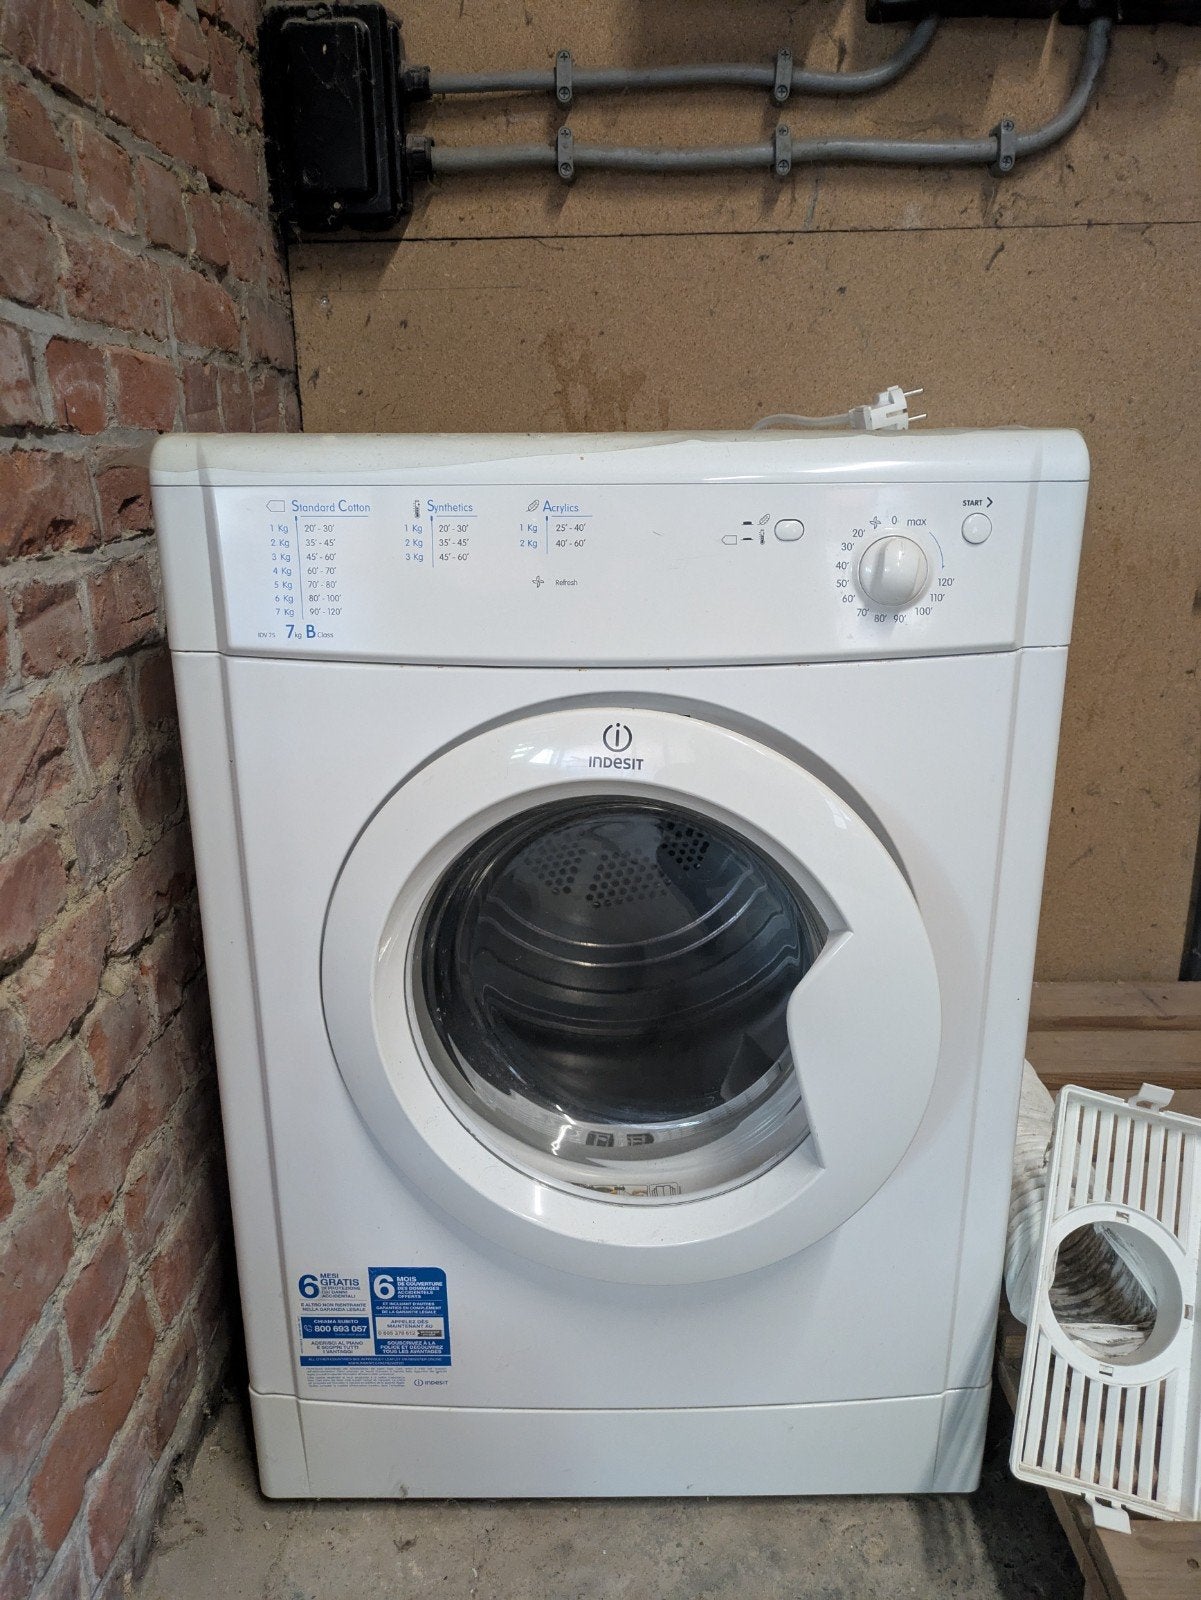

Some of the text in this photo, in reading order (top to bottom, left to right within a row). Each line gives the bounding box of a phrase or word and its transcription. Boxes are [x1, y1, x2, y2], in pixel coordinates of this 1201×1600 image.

[291, 500, 371, 512] Standard Cotton
[427, 499, 473, 513] Synthetics
[543, 500, 579, 514] Acrylics
[891, 516, 897, 524] 0
[278, 524, 288, 534] Kg
[412, 524, 422, 534] Kg
[527, 524, 538, 533] Kg
[852, 529, 866, 538] 20'
[280, 539, 289, 548] Kg
[412, 539, 423, 548] Kg
[527, 539, 538, 549] Kg
[841, 542, 855, 551] 30'
[280, 553, 291, 562] Kg
[413, 553, 424, 562] Kg
[836, 561, 849, 570] 40'
[282, 567, 292, 576] Kg
[282, 581, 293, 590] Kg
[836, 579, 849, 588] 50'
[938, 578, 954, 586] 120'
[284, 595, 294, 604] Kg
[842, 594, 856, 603] 60'
[930, 593, 946, 602] 110'
[284, 608, 294, 617] Kg
[857, 608, 870, 617] 70'
[915, 607, 933, 616] 100'
[874, 614, 888, 623] 80'
[893, 614, 907, 623] 90'
[306, 624, 316, 638] B
[298, 1274, 320, 1299] 6
[374, 1274, 396, 1300] 6
